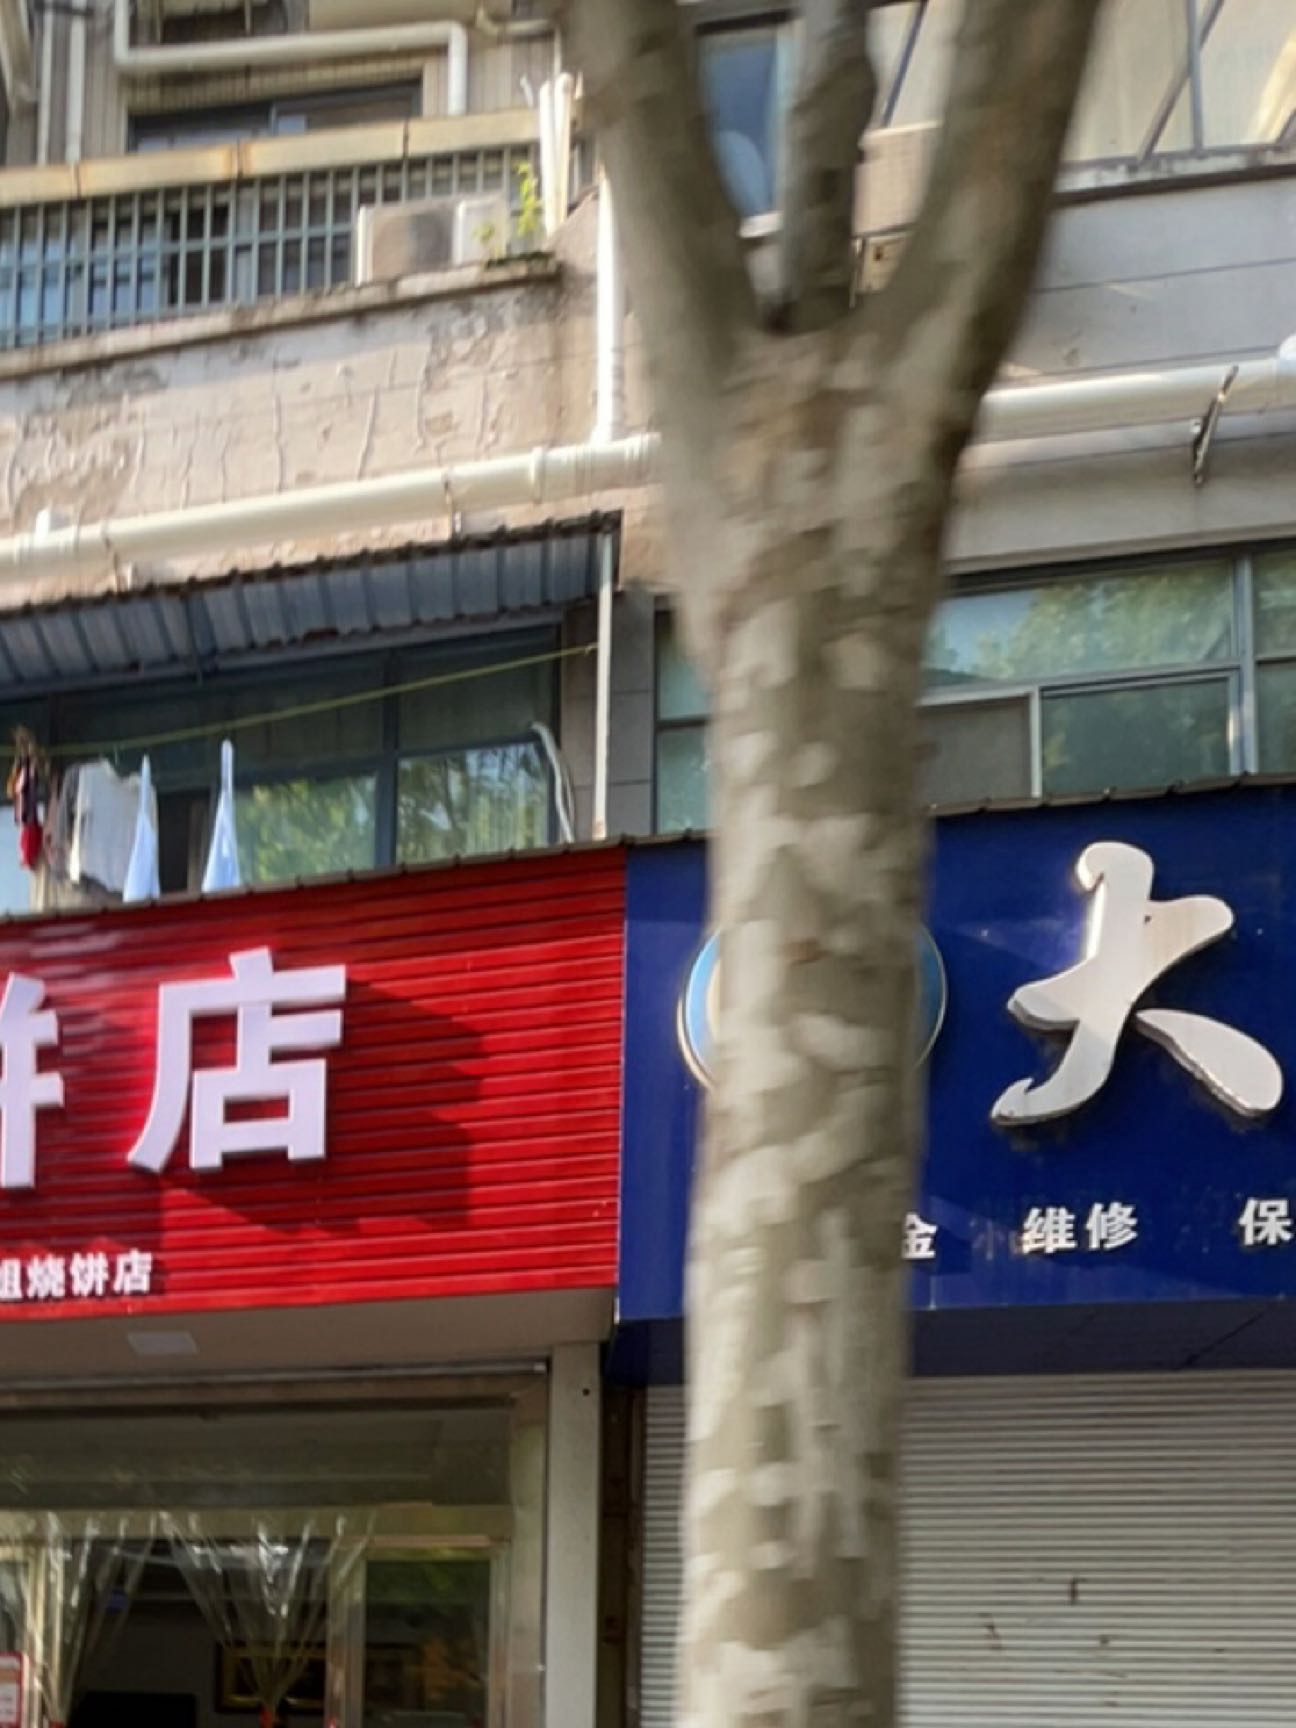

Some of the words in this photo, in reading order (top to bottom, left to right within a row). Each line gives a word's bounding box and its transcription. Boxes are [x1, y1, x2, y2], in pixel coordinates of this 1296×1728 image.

[991, 841, 1284, 1126] 大
[1022, 1202, 1138, 1254] 维修
[1239, 1197, 1294, 1246] 保
